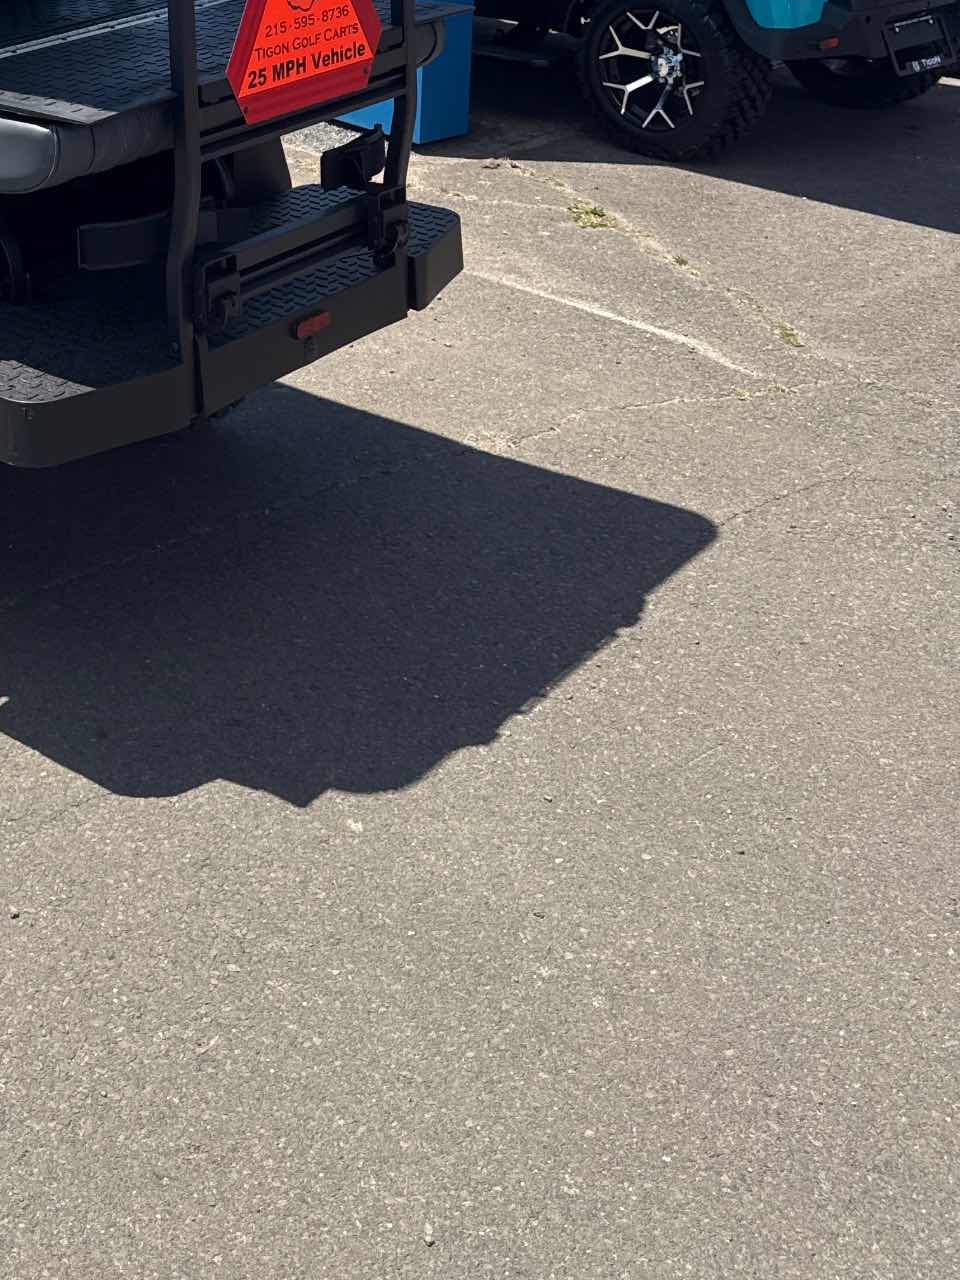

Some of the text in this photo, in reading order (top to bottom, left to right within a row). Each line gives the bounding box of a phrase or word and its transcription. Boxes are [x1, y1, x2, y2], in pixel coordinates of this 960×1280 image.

[254, 23, 359, 61] TIGON GOLF CARTS
[247, 41, 366, 90] 25 MPH Vehicle
